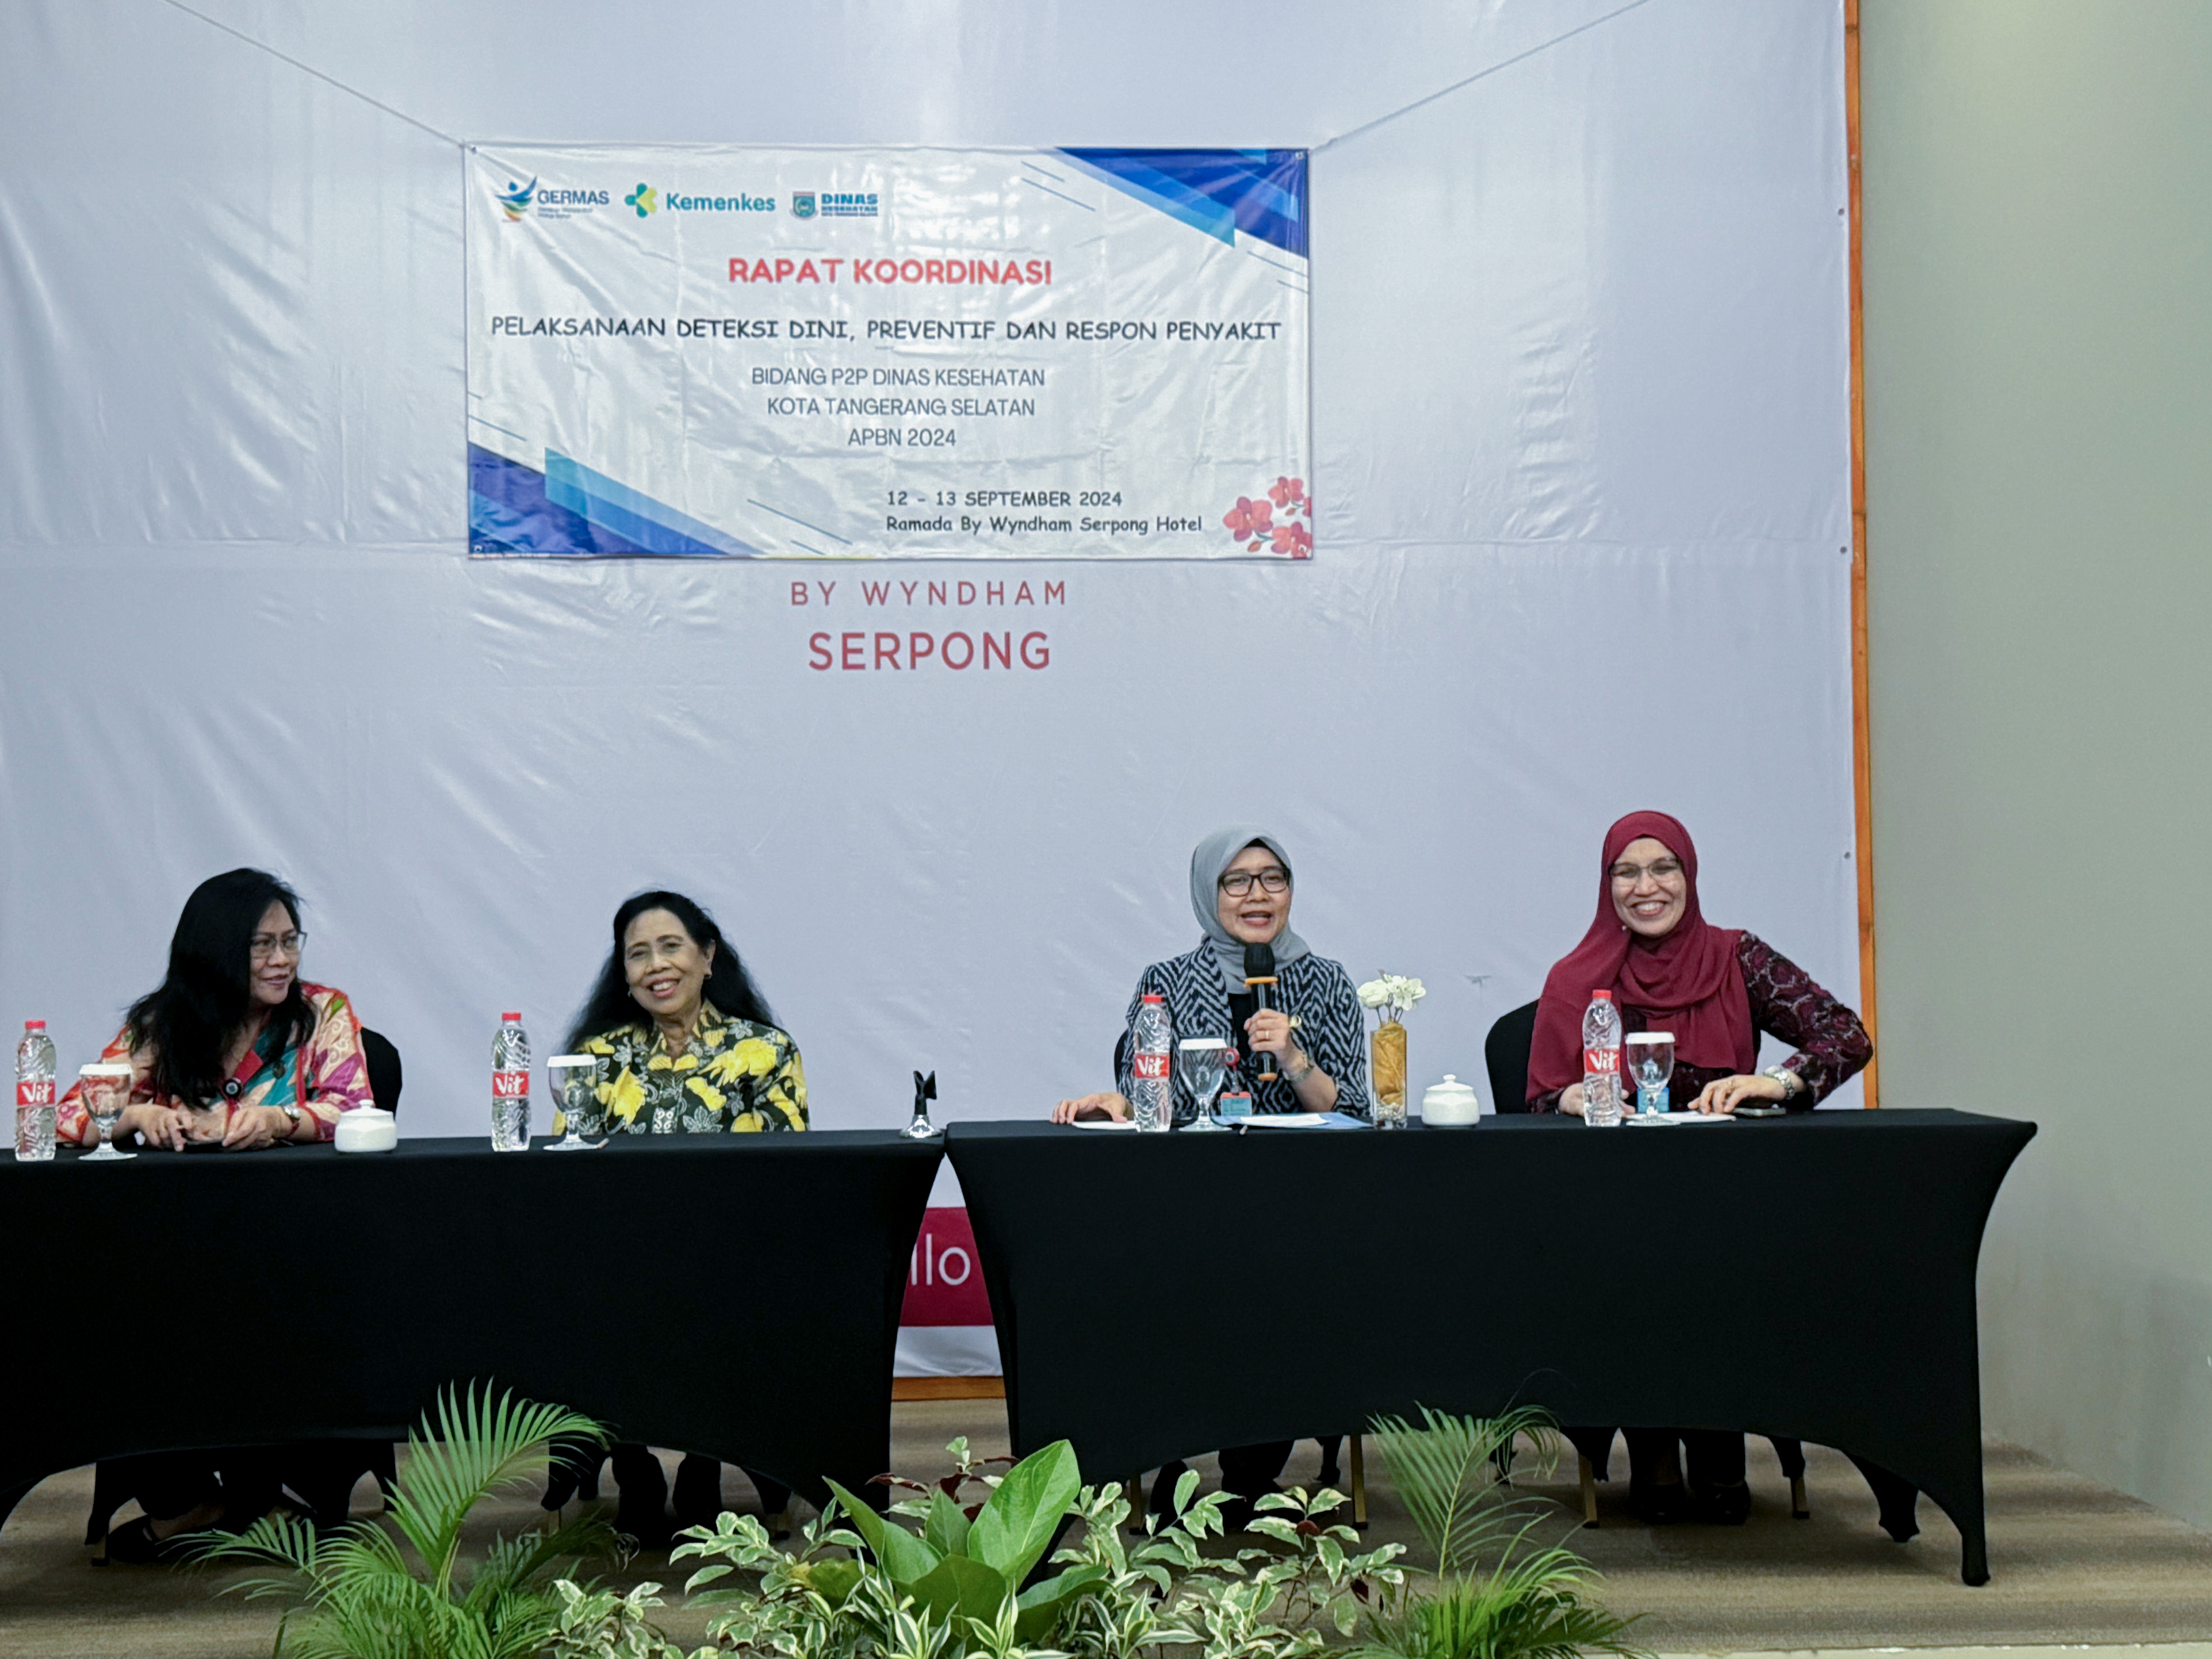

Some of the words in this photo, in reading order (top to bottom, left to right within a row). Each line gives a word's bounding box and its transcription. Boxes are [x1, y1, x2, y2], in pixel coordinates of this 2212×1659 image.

[537, 189, 610, 205] GERMAS
[667, 193, 775, 212] Kemenkes
[821, 194, 878, 204] DINAS
[729, 258, 843, 282] RAPAT
[855, 259, 1051, 285] KOORDINASI
[492, 316, 666, 337] PELAKSANAAN
[677, 318, 779, 339] DETEKSI
[789, 320, 855, 342] DINI,
[867, 320, 996, 340] PREVENTIF
[1007, 321, 1056, 340] DAN
[1066, 321, 1157, 340] RESPON
[1166, 321, 1281, 341] PENYAKIT
[752, 367, 827, 386] BIDANG
[832, 367, 868, 386] P2P
[872, 368, 931, 386] DINAS
[935, 369, 1045, 387] KESEHATAN
[767, 397, 821, 415] KOTA
[824, 397, 947, 416] TANGERANG
[951, 399, 1035, 416] SELATAN
[848, 428, 902, 446] APBN
[907, 428, 956, 447] 2024
[888, 491, 908, 505] 12
[936, 491, 956, 507] 13
[965, 491, 1071, 507] SEPTEMBER
[1079, 491, 1123, 507] 2024
[886, 515, 952, 531] Ramada
[960, 515, 982, 536] By
[989, 515, 1072, 536] Wyndham
[1080, 517, 1149, 536] Serpong
[1157, 515, 1202, 532] Hotel
[791, 581, 835, 606] BY
[862, 581, 1065, 605] WYNDHAM
[809, 631, 1049, 671] SERPONG
[1138, 1056, 1164, 1076] Vit
[1589, 1050, 1617, 1071] Vit
[22, 1082, 52, 1102] Vit
[495, 1074, 524, 1094] Vit
